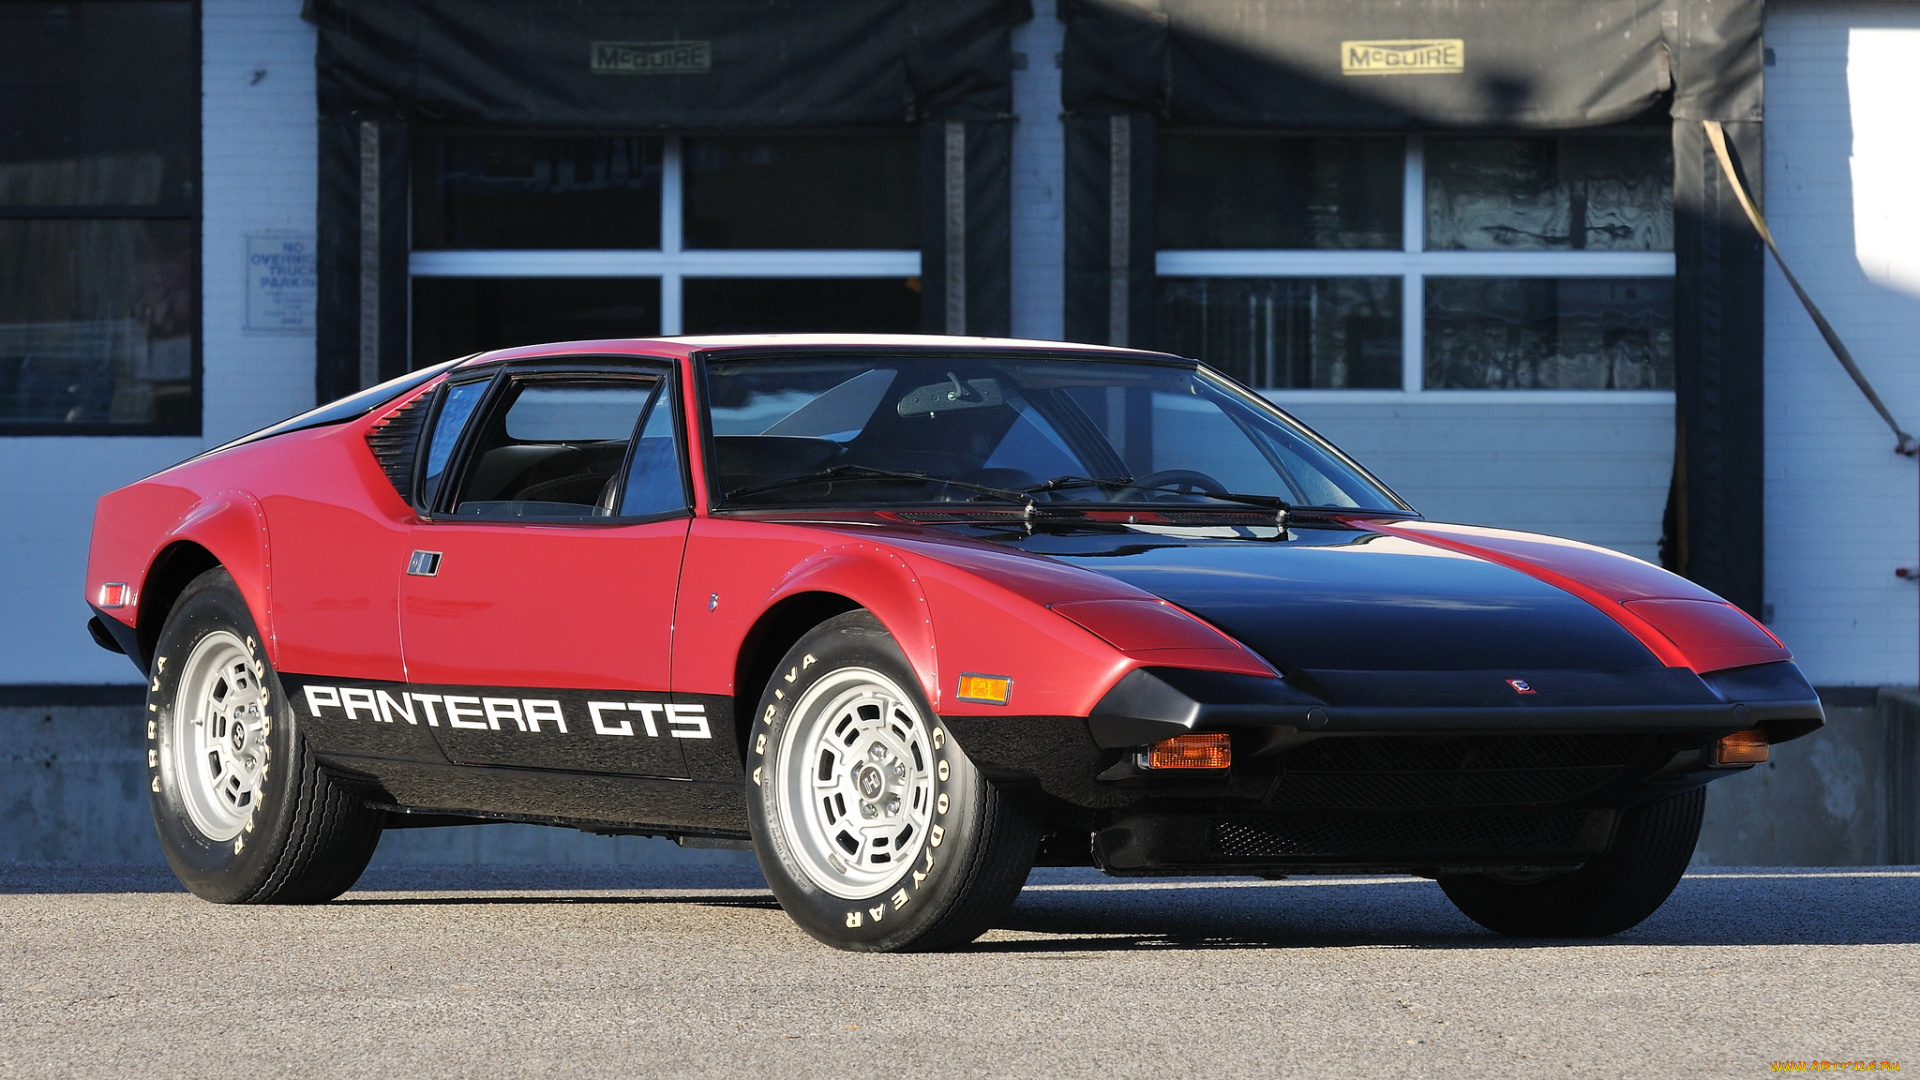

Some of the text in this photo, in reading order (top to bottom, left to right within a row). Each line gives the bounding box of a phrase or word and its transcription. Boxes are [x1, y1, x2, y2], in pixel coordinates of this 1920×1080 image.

[599, 47, 704, 67] McGUIRE
[1350, 45, 1457, 66] McGUIRE
[283, 243, 303, 252] NO
[148, 656, 167, 793] ARRIVA
[234, 635, 273, 856] GOODYEAR
[303, 685, 712, 739] PANTERA GTS
[753, 653, 818, 787] ARRIVA
[846, 726, 950, 928] GOODYEAR
